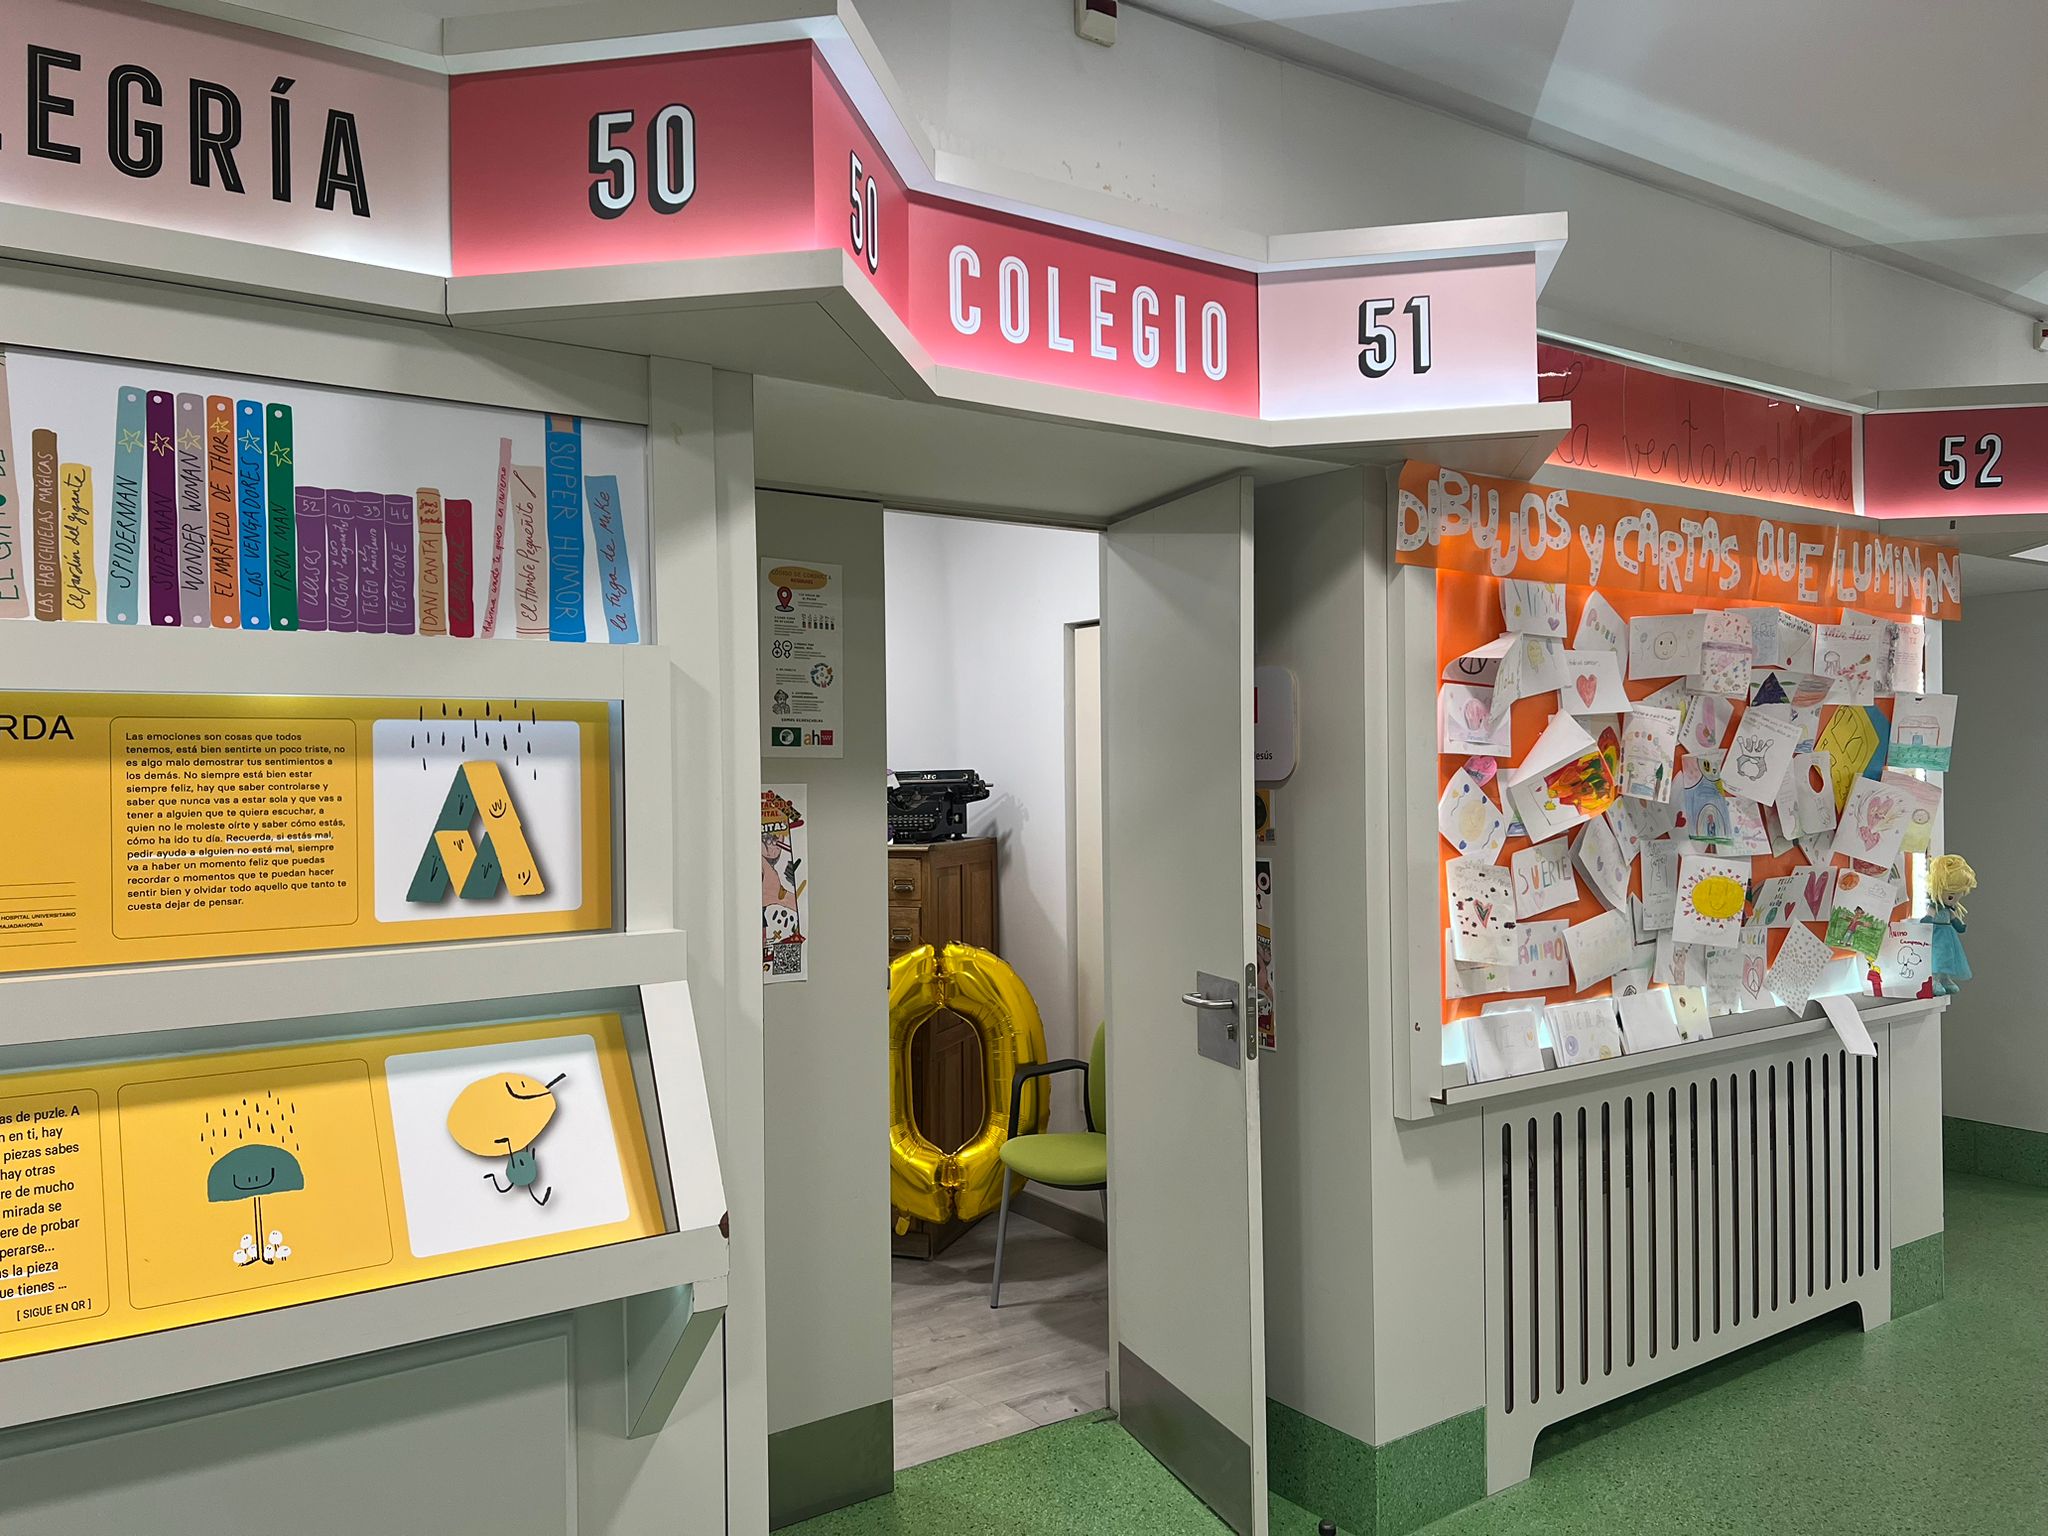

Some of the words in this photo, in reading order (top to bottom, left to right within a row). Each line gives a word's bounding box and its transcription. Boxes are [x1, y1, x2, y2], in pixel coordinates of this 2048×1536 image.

[0, 44, 370, 218] EGRÍA
[589, 103, 696, 219] 50
[849, 150, 879, 275] 50
[949, 244, 1227, 381] COLEGIO
[1358, 295, 1431, 378] 51
[209, 433, 233, 472] THOR
[1623, 400, 1762, 492] ventana
[1768, 421, 1806, 497] del
[1812, 435, 1851, 501] cole
[1939, 432, 2003, 490] 52
[179, 450, 203, 512] WOMAN
[211, 482, 231, 503] DE
[550, 441, 578, 521] SUPER
[63, 469, 90, 525] gigante
[240, 456, 262, 559] VENGADORES
[303, 500, 320, 512] 52
[332, 503, 350, 514] 10
[270, 502, 290, 541] MAN
[363, 506, 380, 517] 39
[390, 507, 409, 519] 46
[64, 525, 80, 546] del
[110, 476, 138, 588] SPIDERMAN
[152, 492, 173, 591] SUPERMAN
[1396, 468, 1571, 576] DIBUJOS
[1614, 508, 1741, 592] CARTAS
[1757, 520, 1824, 602] QUE
[36, 509, 56, 587] HABICHUELAS
[209, 511, 234, 578] MARTILLO
[600, 538, 616, 563] de
[181, 523, 206, 590] WONDER
[423, 539, 438, 584] CANTA
[273, 550, 292, 591] IRON
[552, 535, 582, 620] HUMOR
[213, 582, 234, 598] EL
[244, 570, 264, 598] LOS
[516, 563, 540, 603] Hombre
[38, 593, 54, 613] LAS
[67, 593, 86, 610] El
[361, 580, 379, 615] TESEO
[521, 599, 538, 622] El
[147, 733, 201, 741] emociones
[276, 733, 302, 741] todos
[126, 746, 173, 754] tenemos,
[176, 745, 197, 753] está
[280, 747, 302, 755] poco
[305, 746, 331, 754] triste,
[1255, 751, 1273, 760] esús
[127, 772, 141, 780] los
[201, 771, 240, 780] siempre
[243, 770, 263, 778] está
[267, 770, 286, 778] bien
[141, 758, 162, 769] algo
[166, 758, 190, 766] malo
[193, 758, 244, 766] demostrar
[127, 785, 167, 794] siempre
[171, 784, 194, 793] feliz,
[197, 784, 215, 793] hay
[218, 785, 235, 793] que
[239, 783, 265, 791] saber
[268, 783, 320, 791] controlarse
[127, 837, 155, 845] cómo
[159, 836, 171, 844] ha
[206, 835, 223, 843] día.
[226, 833, 273, 842] Recuerda,
[287, 832, 312, 840] estás
[315, 831, 334, 839] mal,
[1518, 856, 1571, 895] SUERTE
[31, 911, 76, 919] UNIVERSITARIO
[16, 1111, 30, 1122] de
[34, 1107, 68, 1123] puzle.
[71, 1105, 80, 1116] A
[9, 1132, 23, 1142] en
[27, 1128, 38, 1140] ti,
[42, 1127, 63, 1139] hay
[4, 1149, 42, 1164] piezas
[45, 1143, 79, 1156] sabes
[0, 1169, 22, 1181] hay
[25, 1165, 56, 1177] otras
[15, 1185, 30, 1198] de
[34, 1180, 75, 1195] mucho
[3, 1203, 45, 1219] mirada
[48, 1202, 62, 1212] se
[22, 1223, 37, 1235] de
[41, 1218, 80, 1236] probar
[13, 1265, 23, 1276] la
[27, 1261, 59, 1277] pieza
[18, 1282, 55, 1296] tienes
[23, 1305, 53, 1319] SIGUE
[55, 1303, 69, 1313] EN
[71, 1300, 86, 1311] QR
